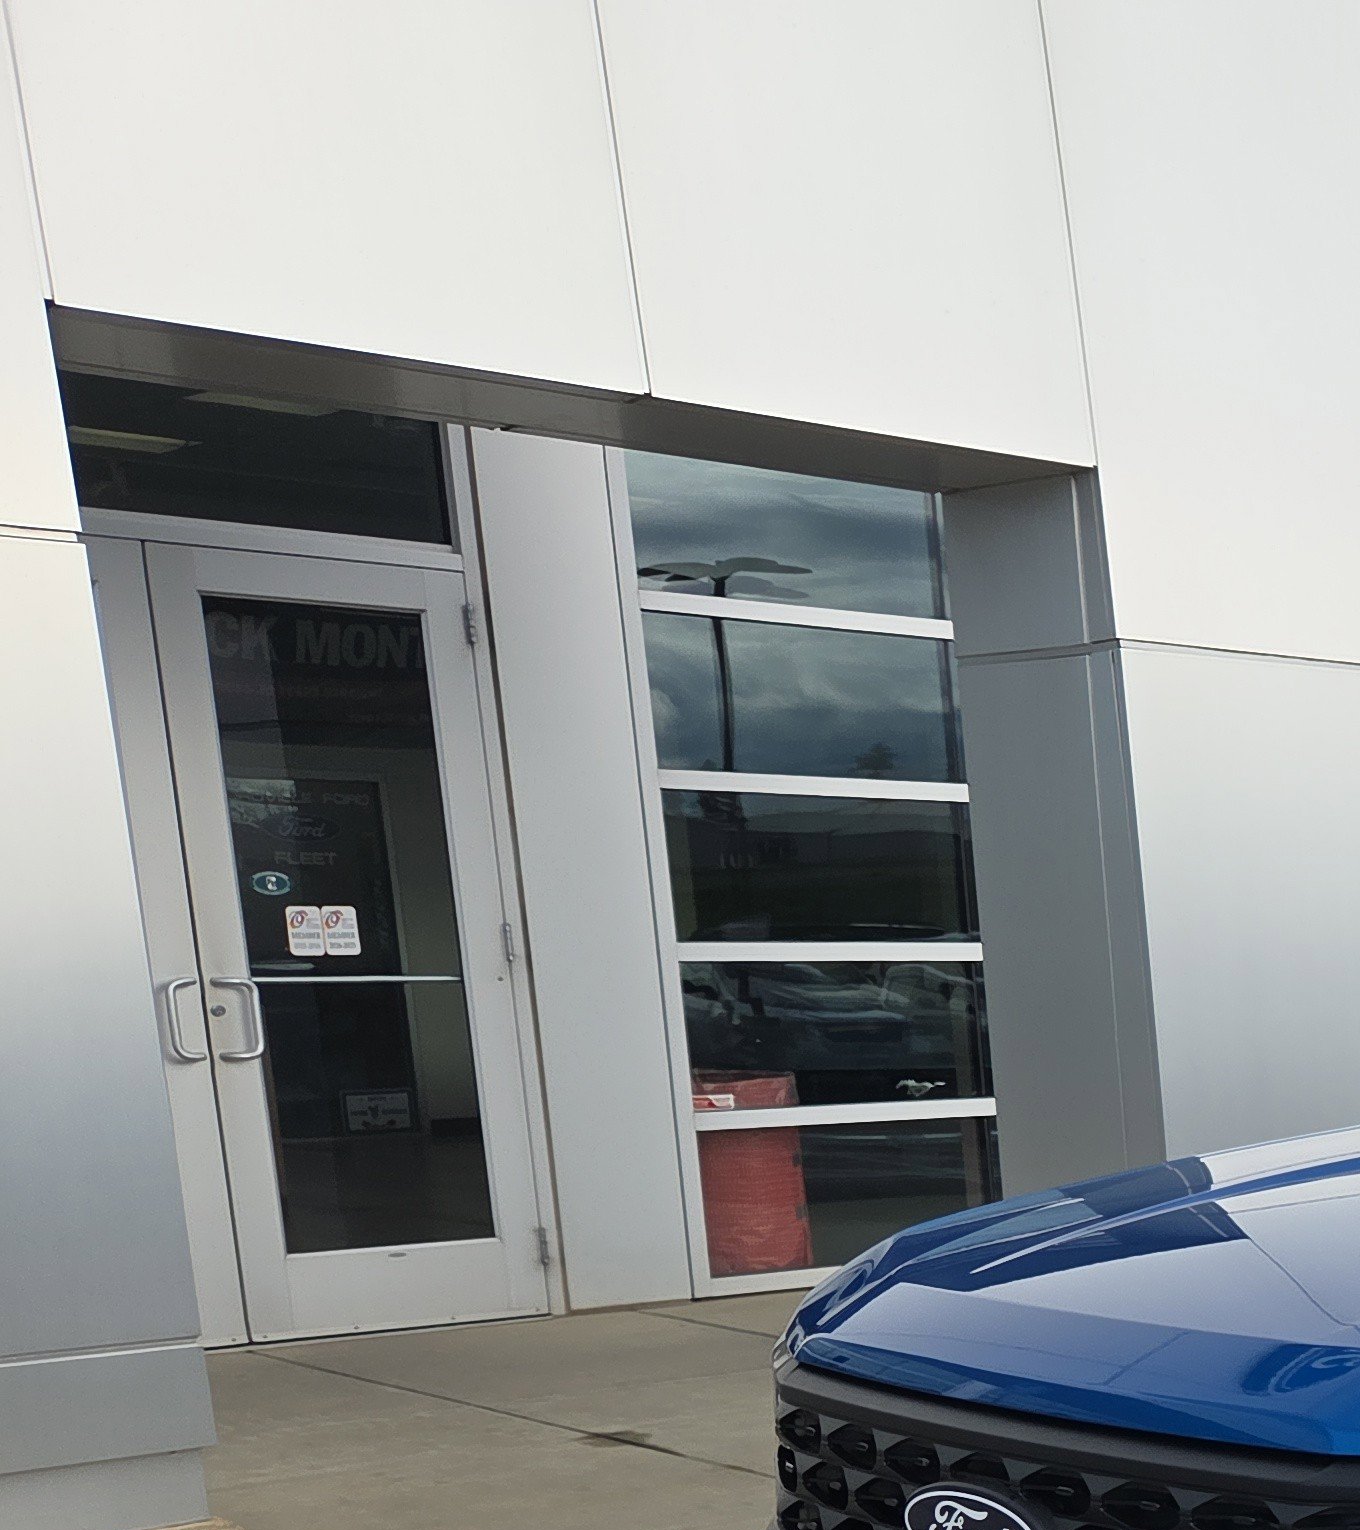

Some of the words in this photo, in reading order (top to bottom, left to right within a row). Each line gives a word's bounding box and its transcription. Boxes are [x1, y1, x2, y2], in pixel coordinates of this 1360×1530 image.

[205, 611, 277, 661] CK
[279, 816, 326, 837] Ford
[274, 851, 337, 866] FLEET
